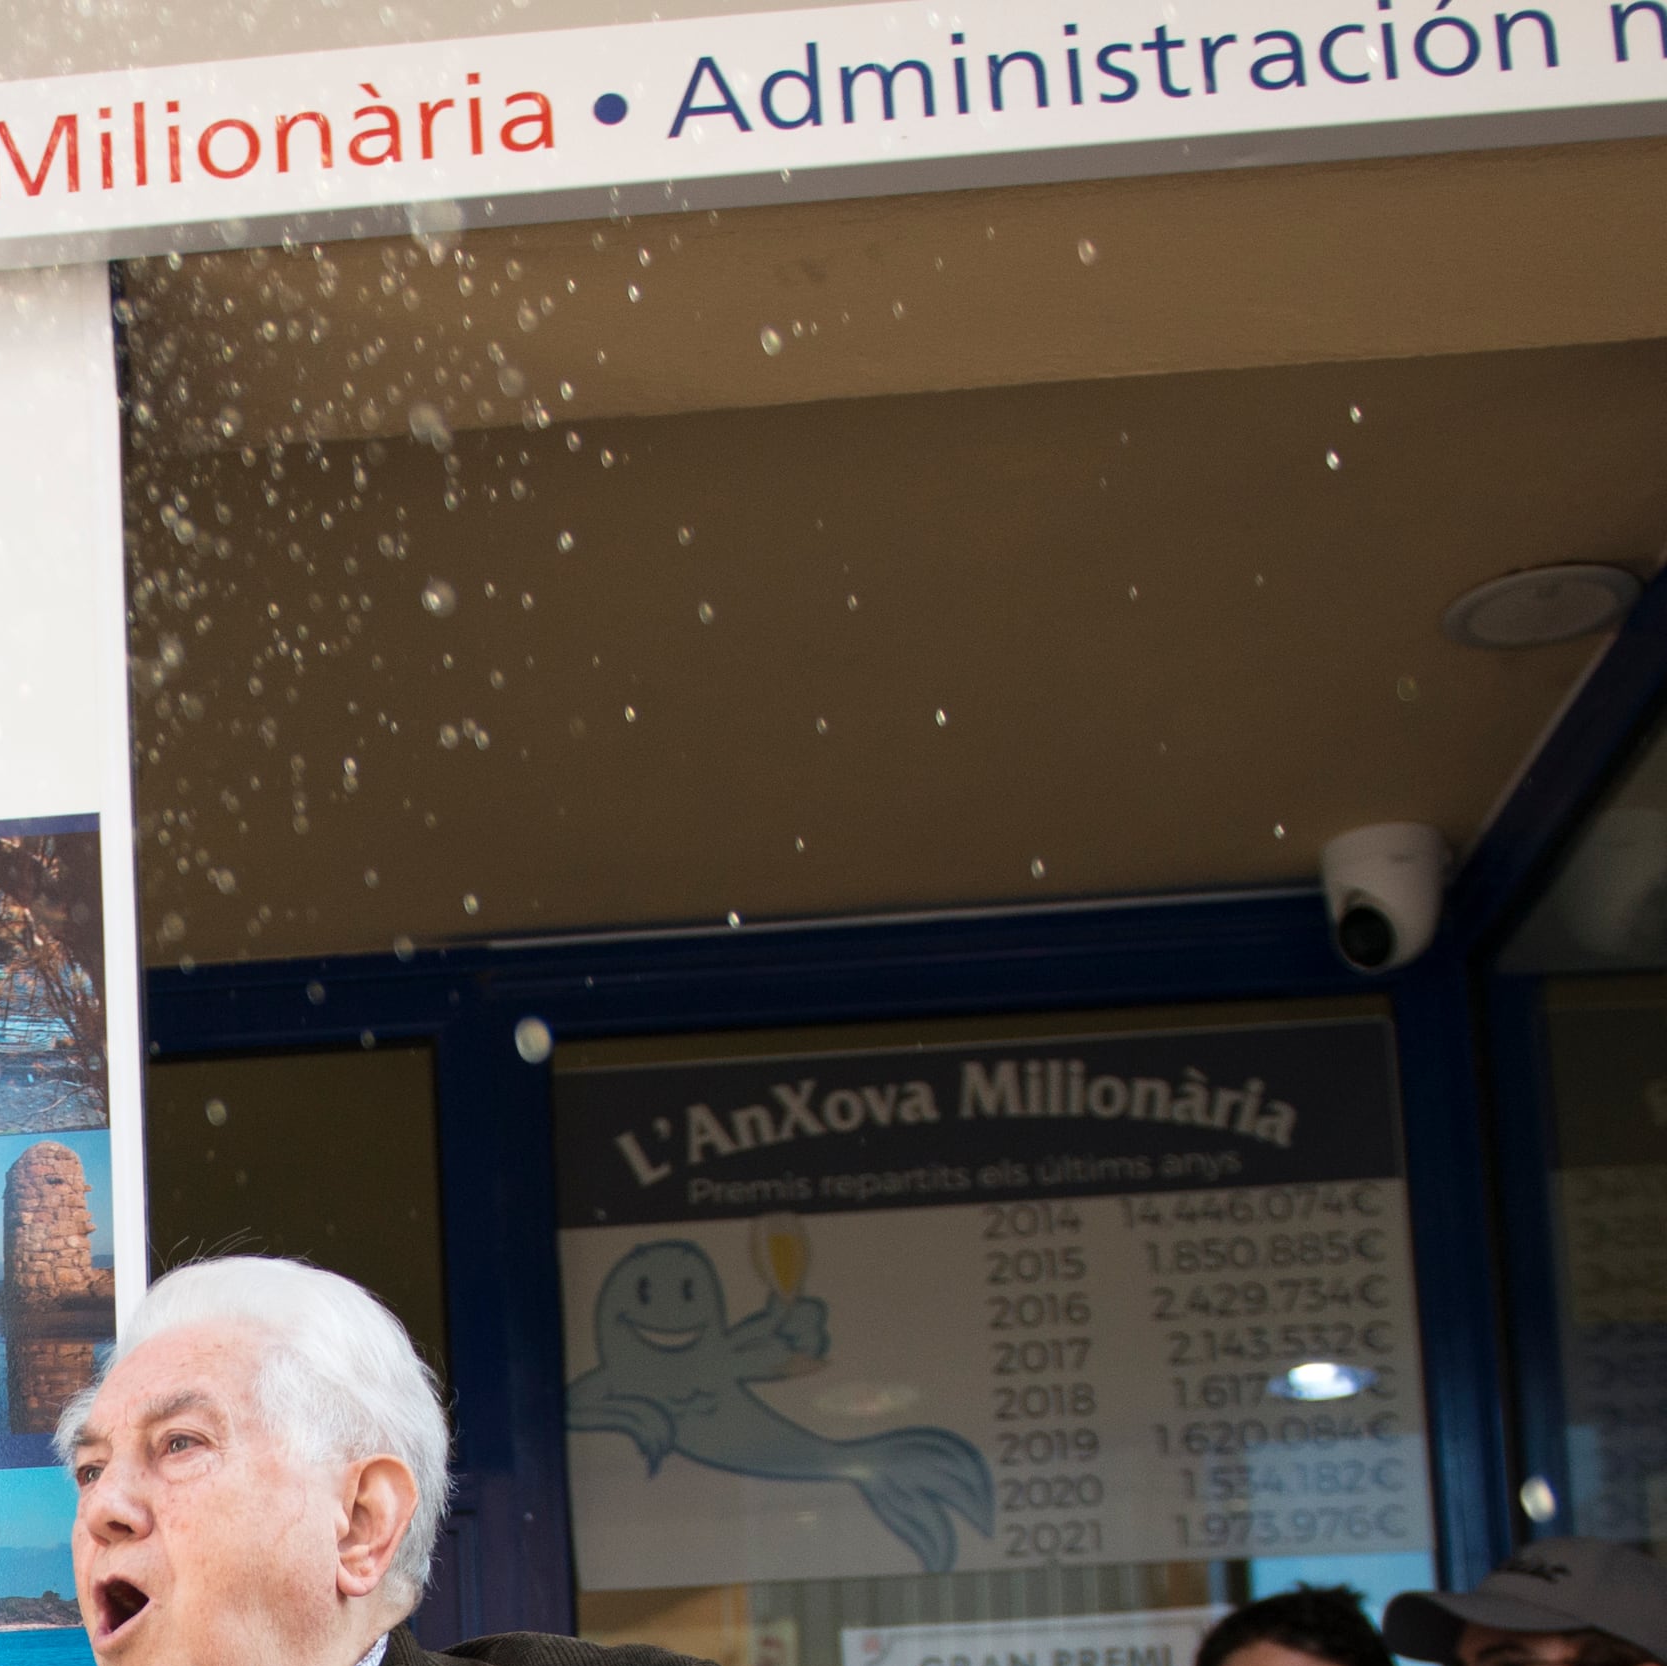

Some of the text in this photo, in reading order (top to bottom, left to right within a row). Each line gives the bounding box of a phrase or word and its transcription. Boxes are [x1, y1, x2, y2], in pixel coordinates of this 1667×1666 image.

[667, 0, 1559, 138] Administración
[616, 1059, 1299, 1188] L'AnXova Milionària
[688, 1148, 1243, 1205] Premis repartits els últims anys
[983, 1205, 1083, 1241] 2014
[985, 1247, 1087, 1285] 2015
[988, 1291, 1091, 1331] 2016
[992, 1337, 1094, 1376] 2017
[995, 1383, 1097, 1421] 2018
[997, 1428, 1101, 1466] 2019
[1000, 1474, 1105, 1513] 2020
[1004, 1519, 1104, 1558] 2021
